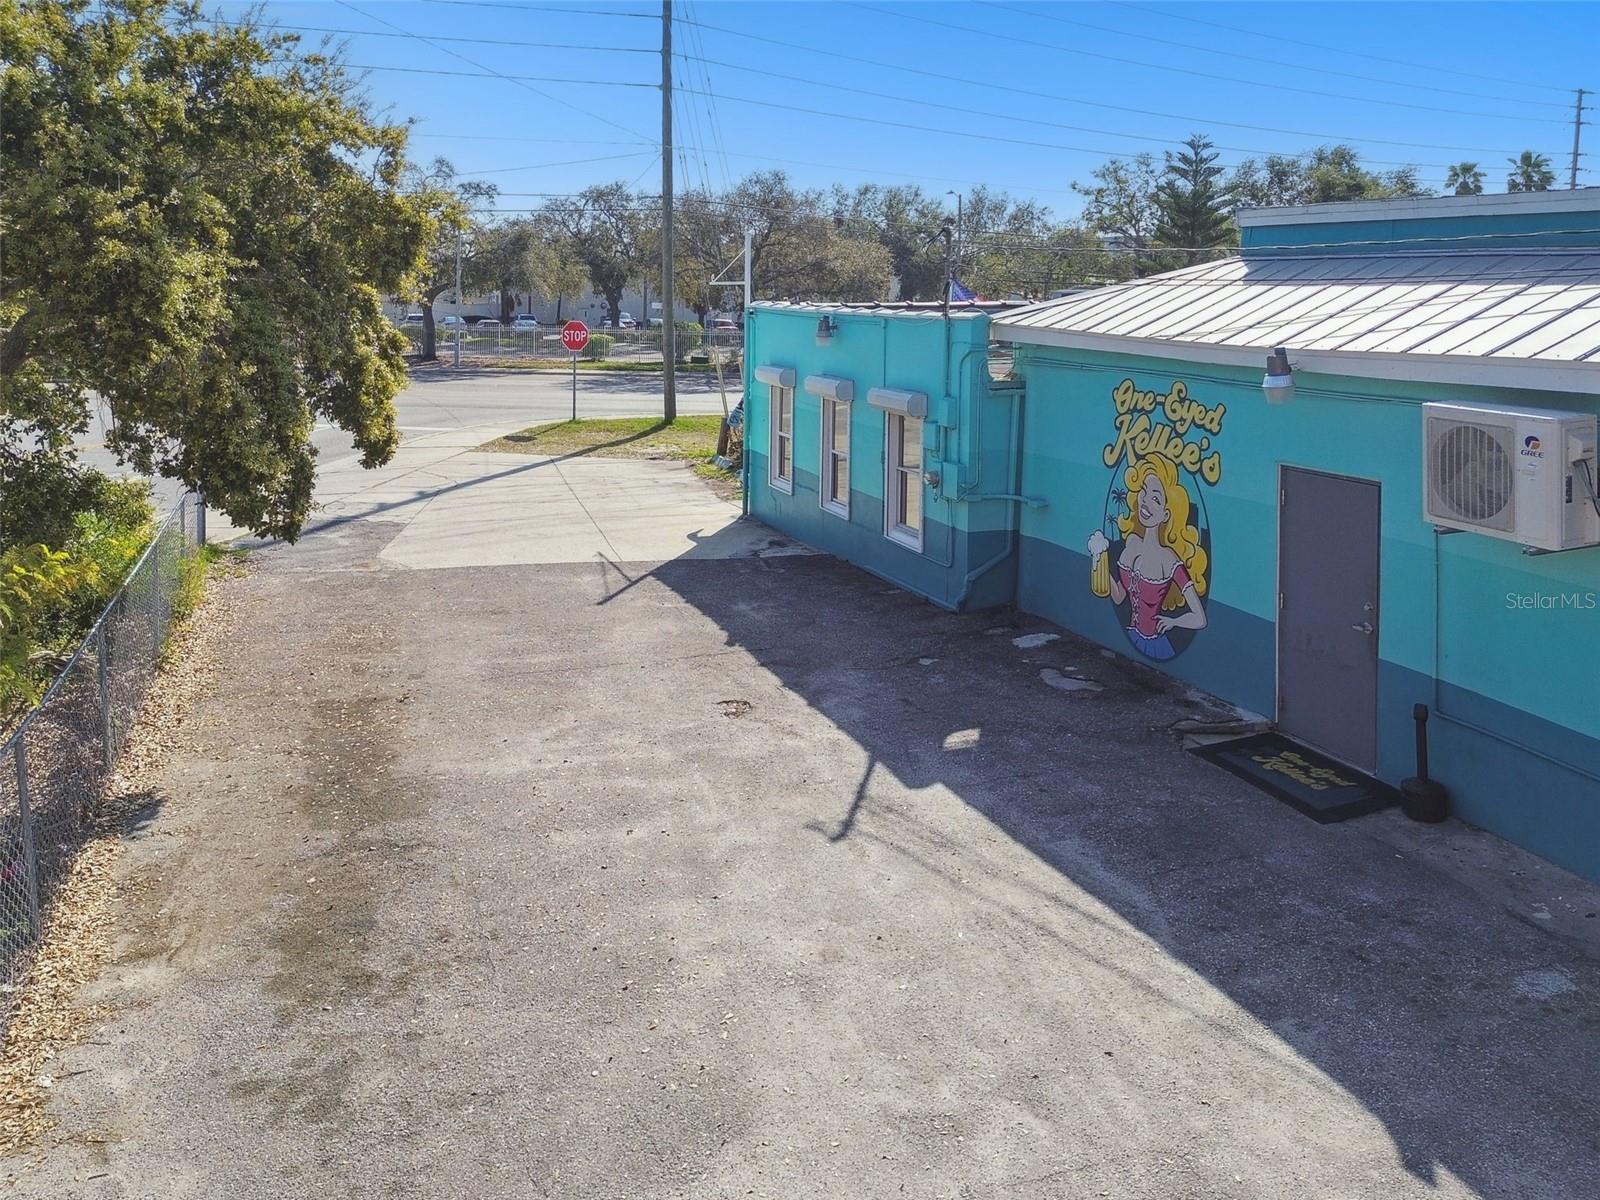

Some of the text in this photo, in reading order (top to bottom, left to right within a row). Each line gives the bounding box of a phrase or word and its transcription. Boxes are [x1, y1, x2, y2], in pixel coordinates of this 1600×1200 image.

[563, 330, 587, 341] STOP
[1112, 378, 1226, 436] One-Eyed
[1103, 413, 1221, 487] Kellee's
[1520, 449, 1545, 459] GREE
